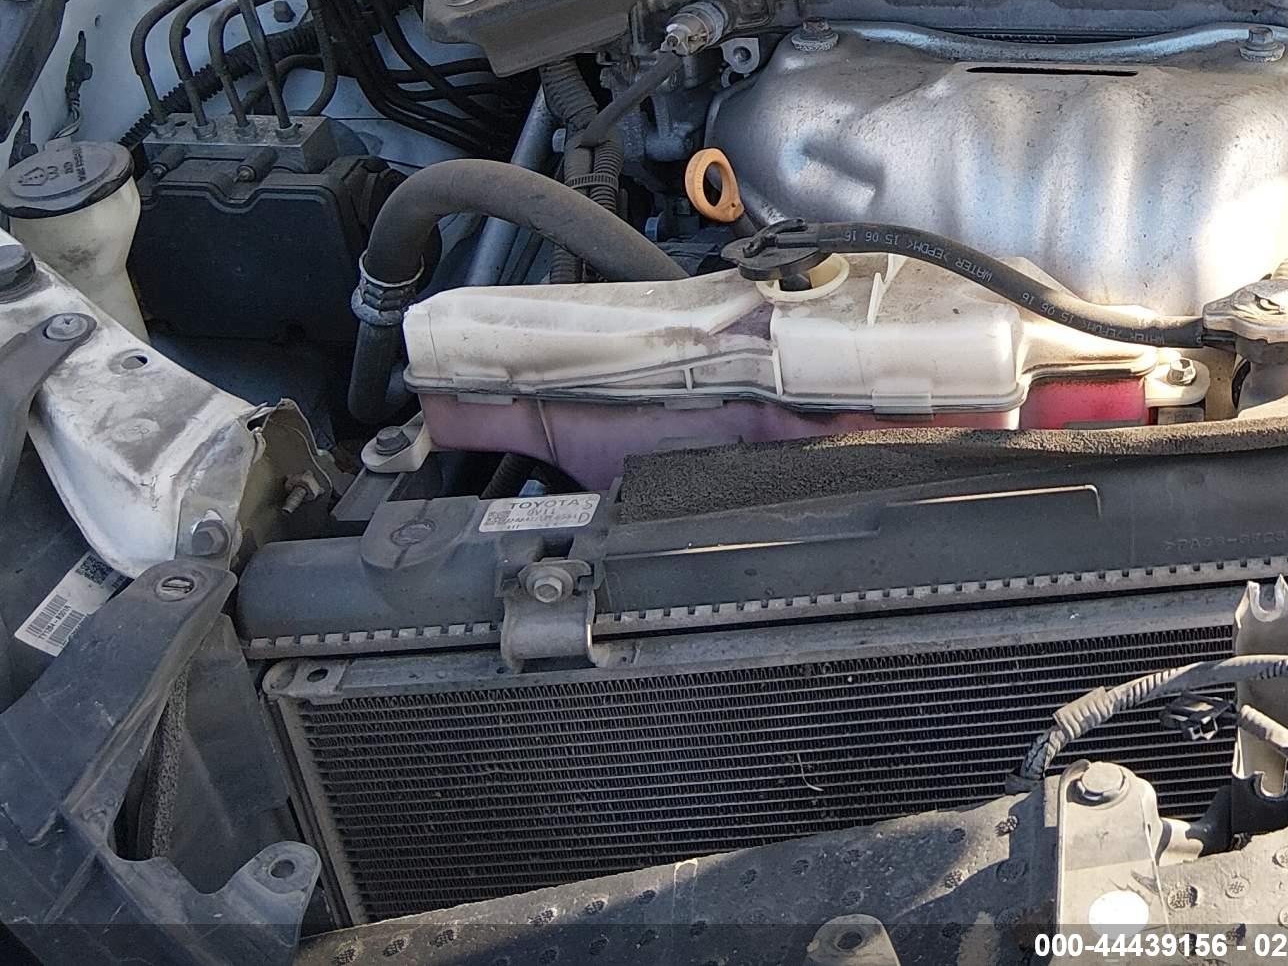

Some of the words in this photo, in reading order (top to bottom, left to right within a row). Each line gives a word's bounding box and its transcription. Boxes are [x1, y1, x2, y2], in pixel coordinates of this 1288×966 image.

[864, 231, 879, 243] 06
[884, 234, 899, 246] 15
[906, 239, 950, 262] >EPDM<
[954, 257, 993, 283] WATER
[1021, 291, 1035, 306] 16
[1040, 301, 1056, 316] 06
[1060, 311, 1074, 324] 15
[510, 498, 580, 510] TOYOTA
